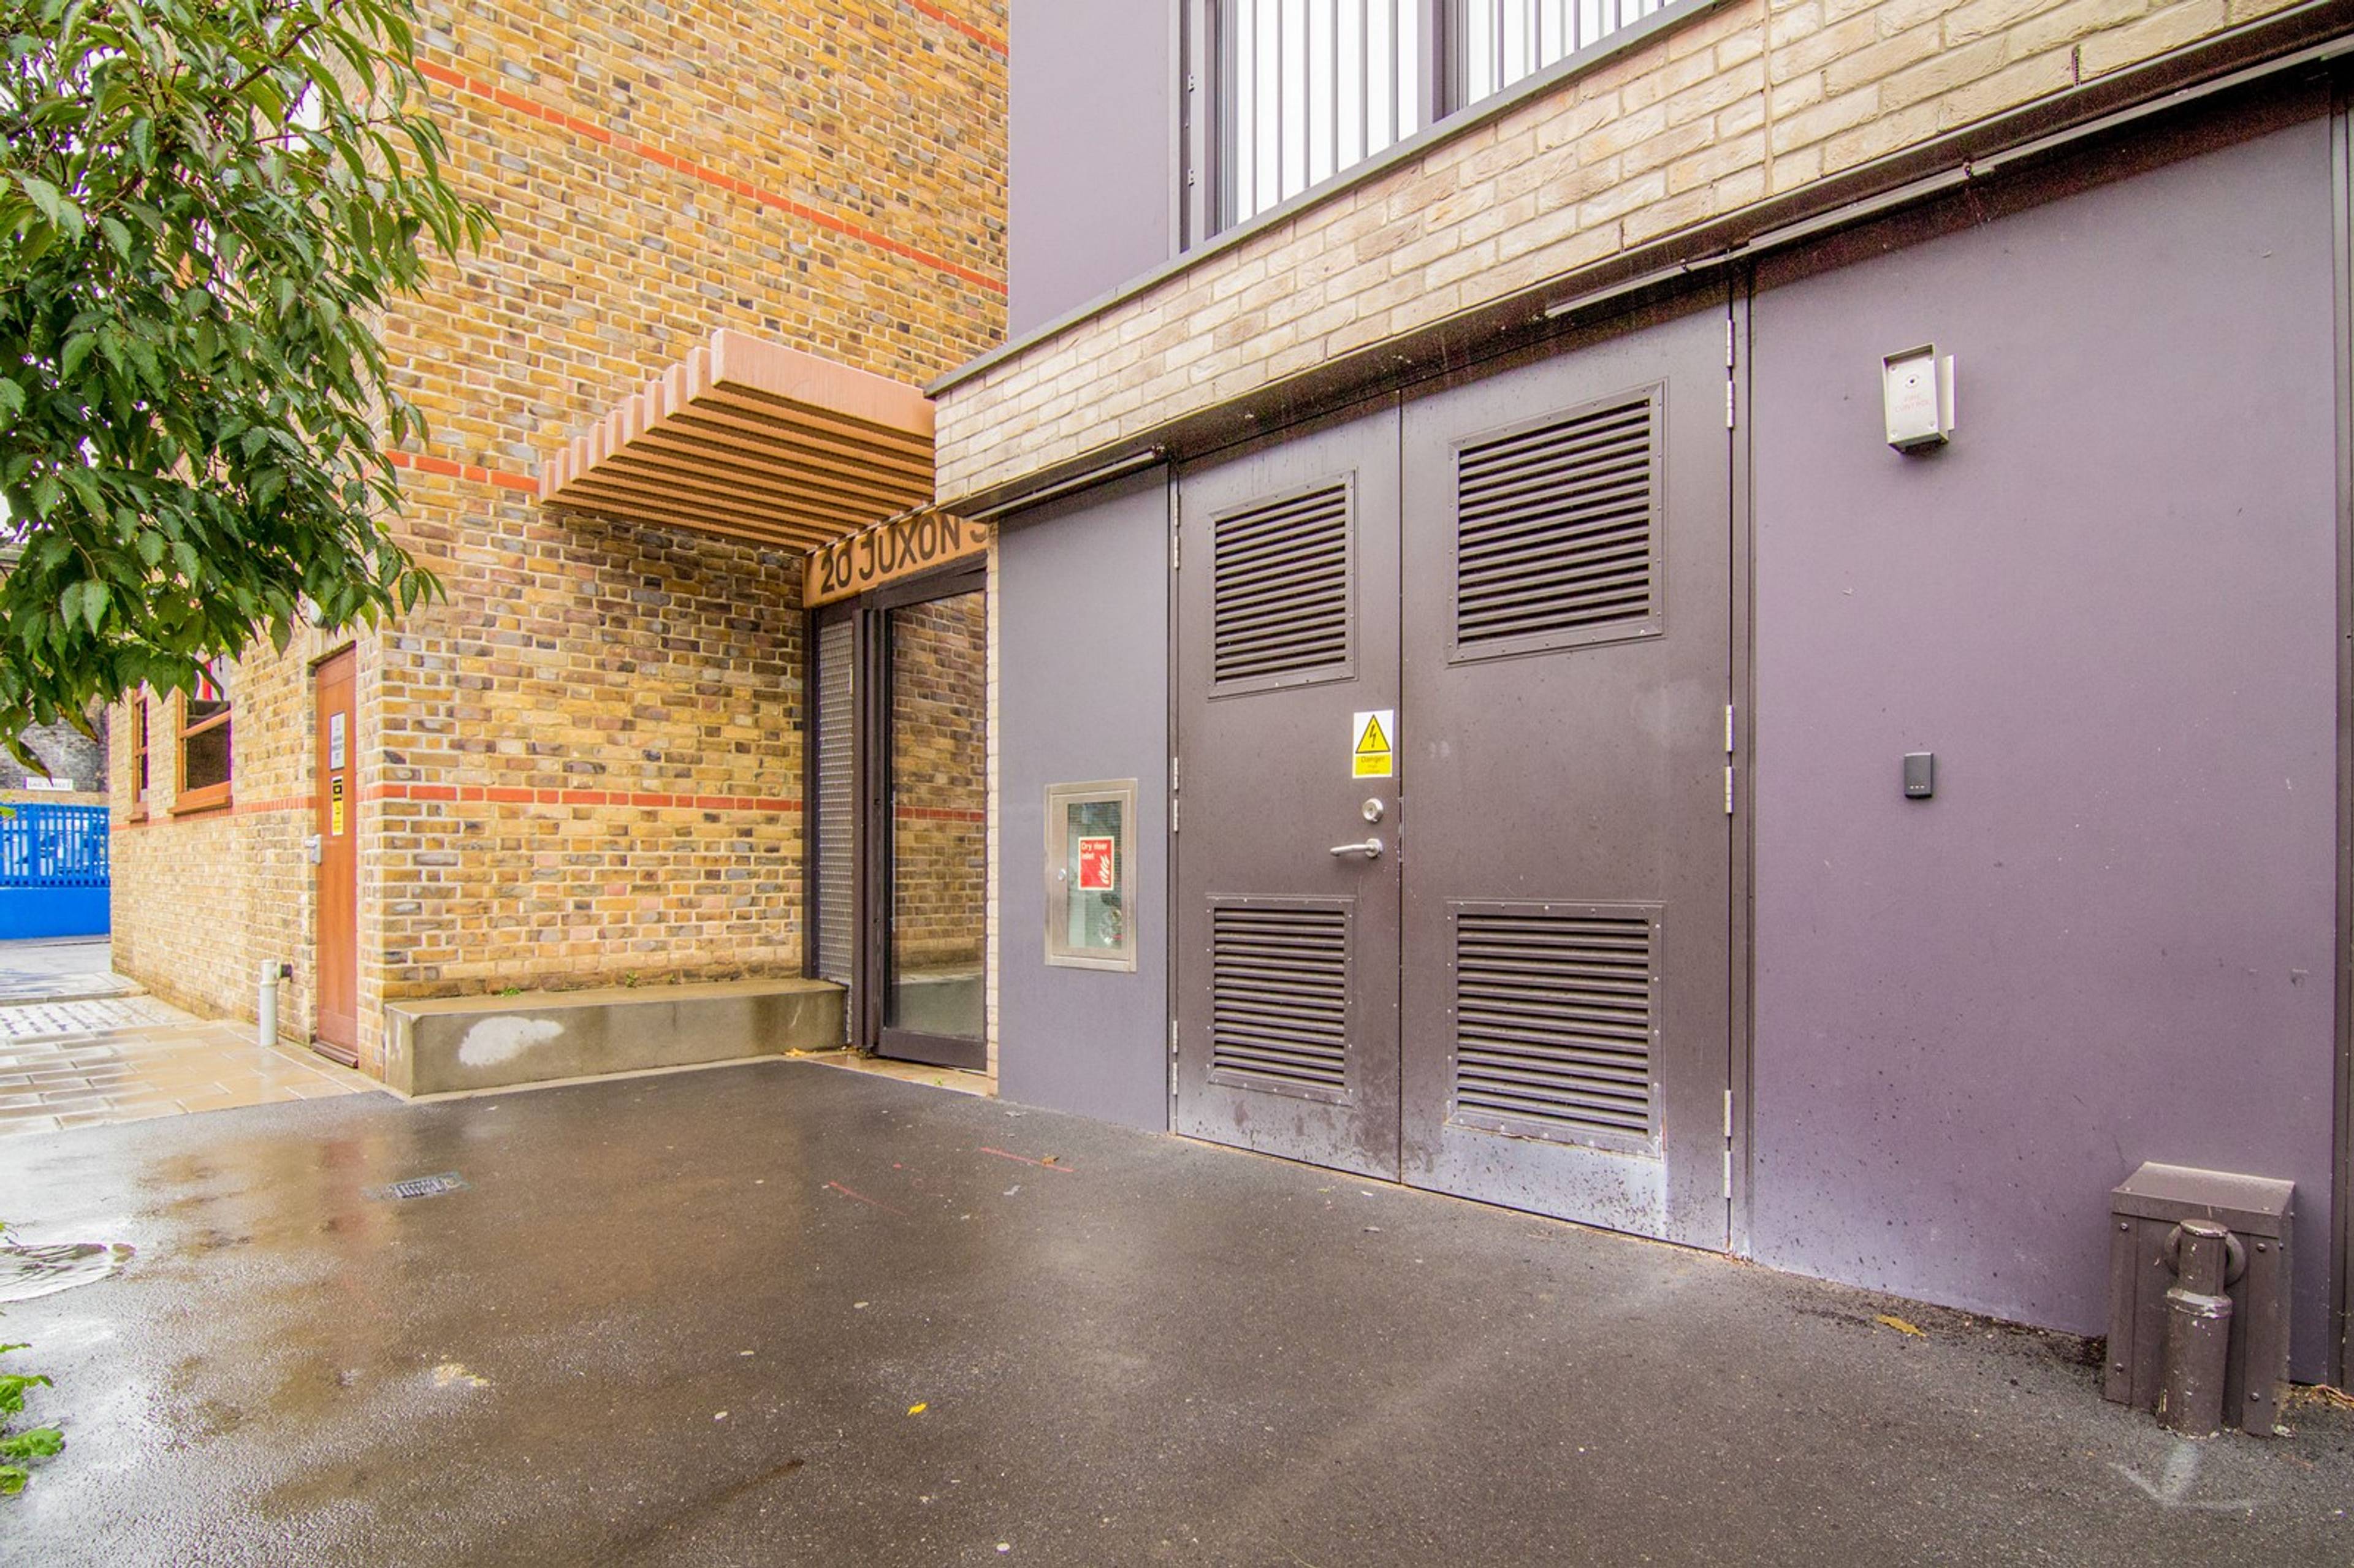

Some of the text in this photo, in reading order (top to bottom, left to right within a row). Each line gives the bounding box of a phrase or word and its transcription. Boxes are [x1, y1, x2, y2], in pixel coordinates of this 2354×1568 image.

[821, 514, 960, 595] 20 JUXON
[1081, 842, 1092, 851] Dry
